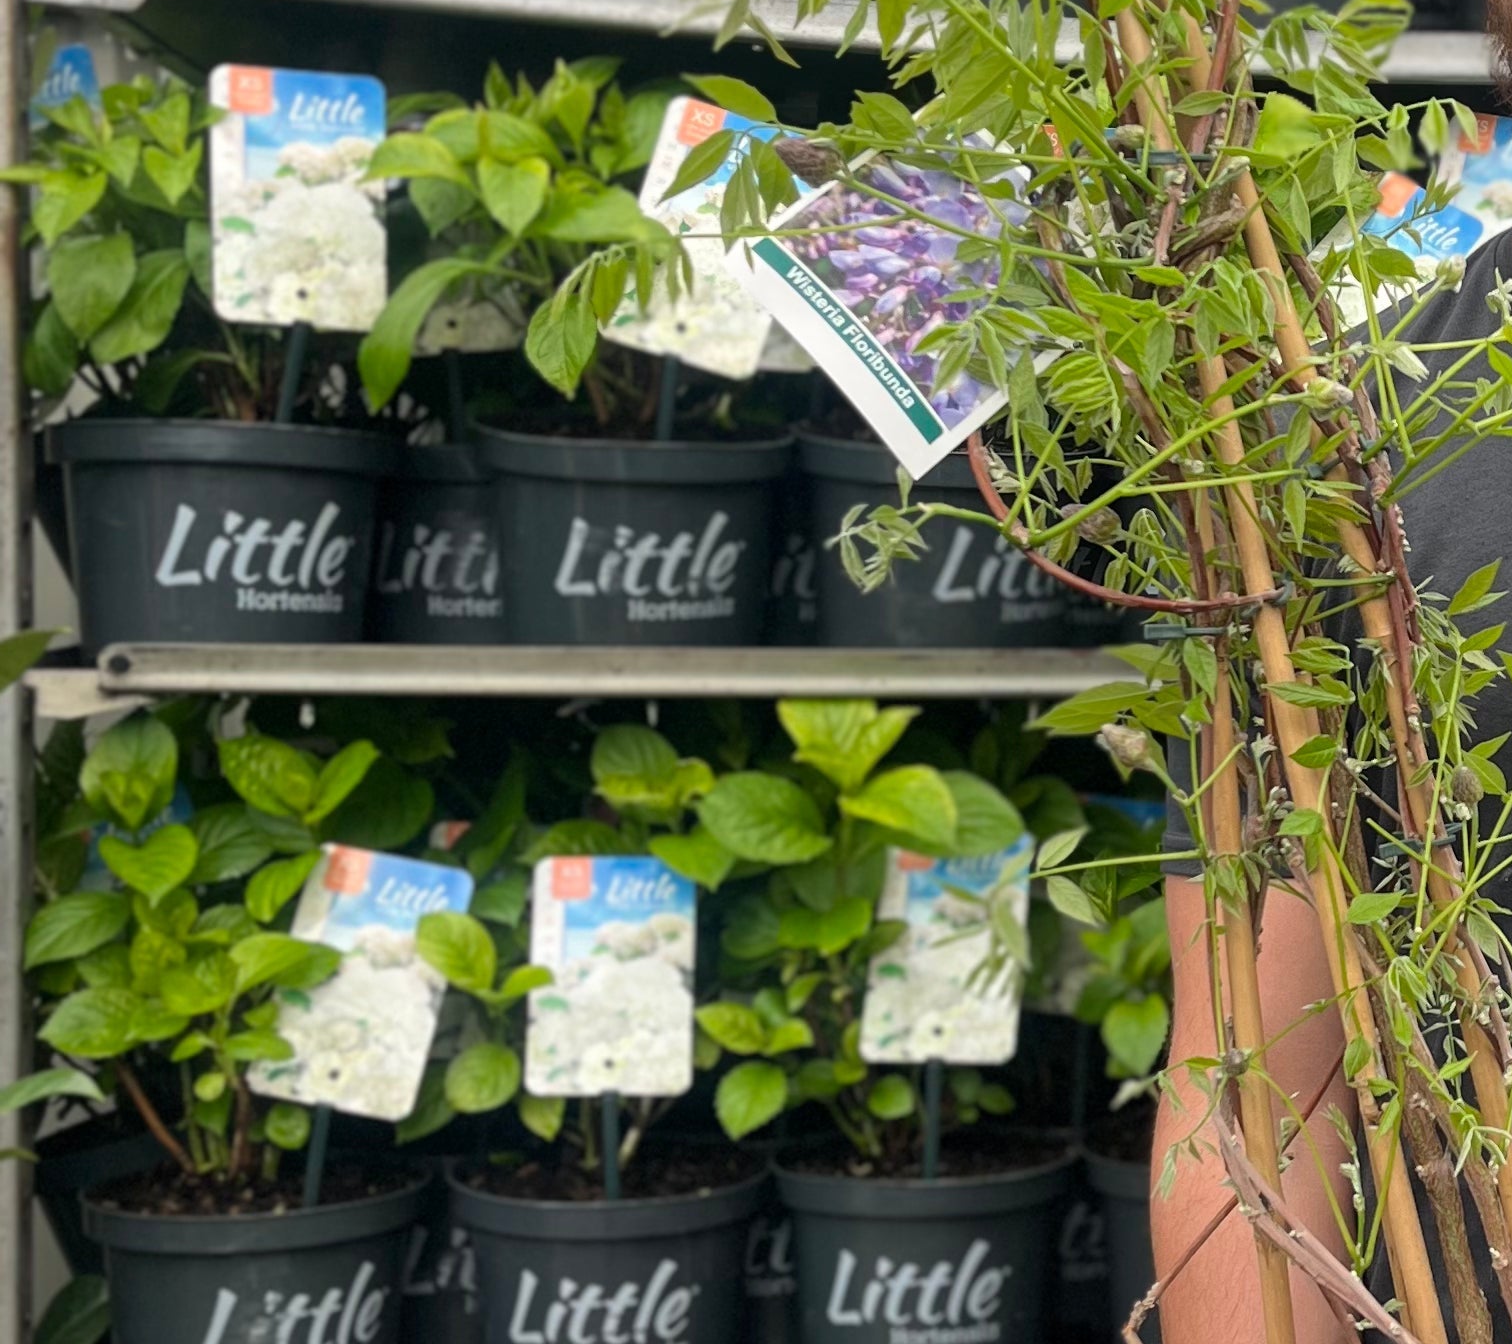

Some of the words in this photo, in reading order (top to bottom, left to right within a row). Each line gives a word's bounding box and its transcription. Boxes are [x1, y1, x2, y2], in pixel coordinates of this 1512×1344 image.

[288, 92, 365, 124] Little
[690, 108, 716, 128] XS
[1415, 217, 1461, 251] ittle
[786, 265, 846, 328] Wisteria
[842, 325, 916, 410] Floribunda
[155, 501, 348, 587] Little
[554, 510, 738, 597] Little
[375, 876, 449, 912] Little
[605, 872, 678, 905] Little
[826, 1238, 1004, 1326] Little
